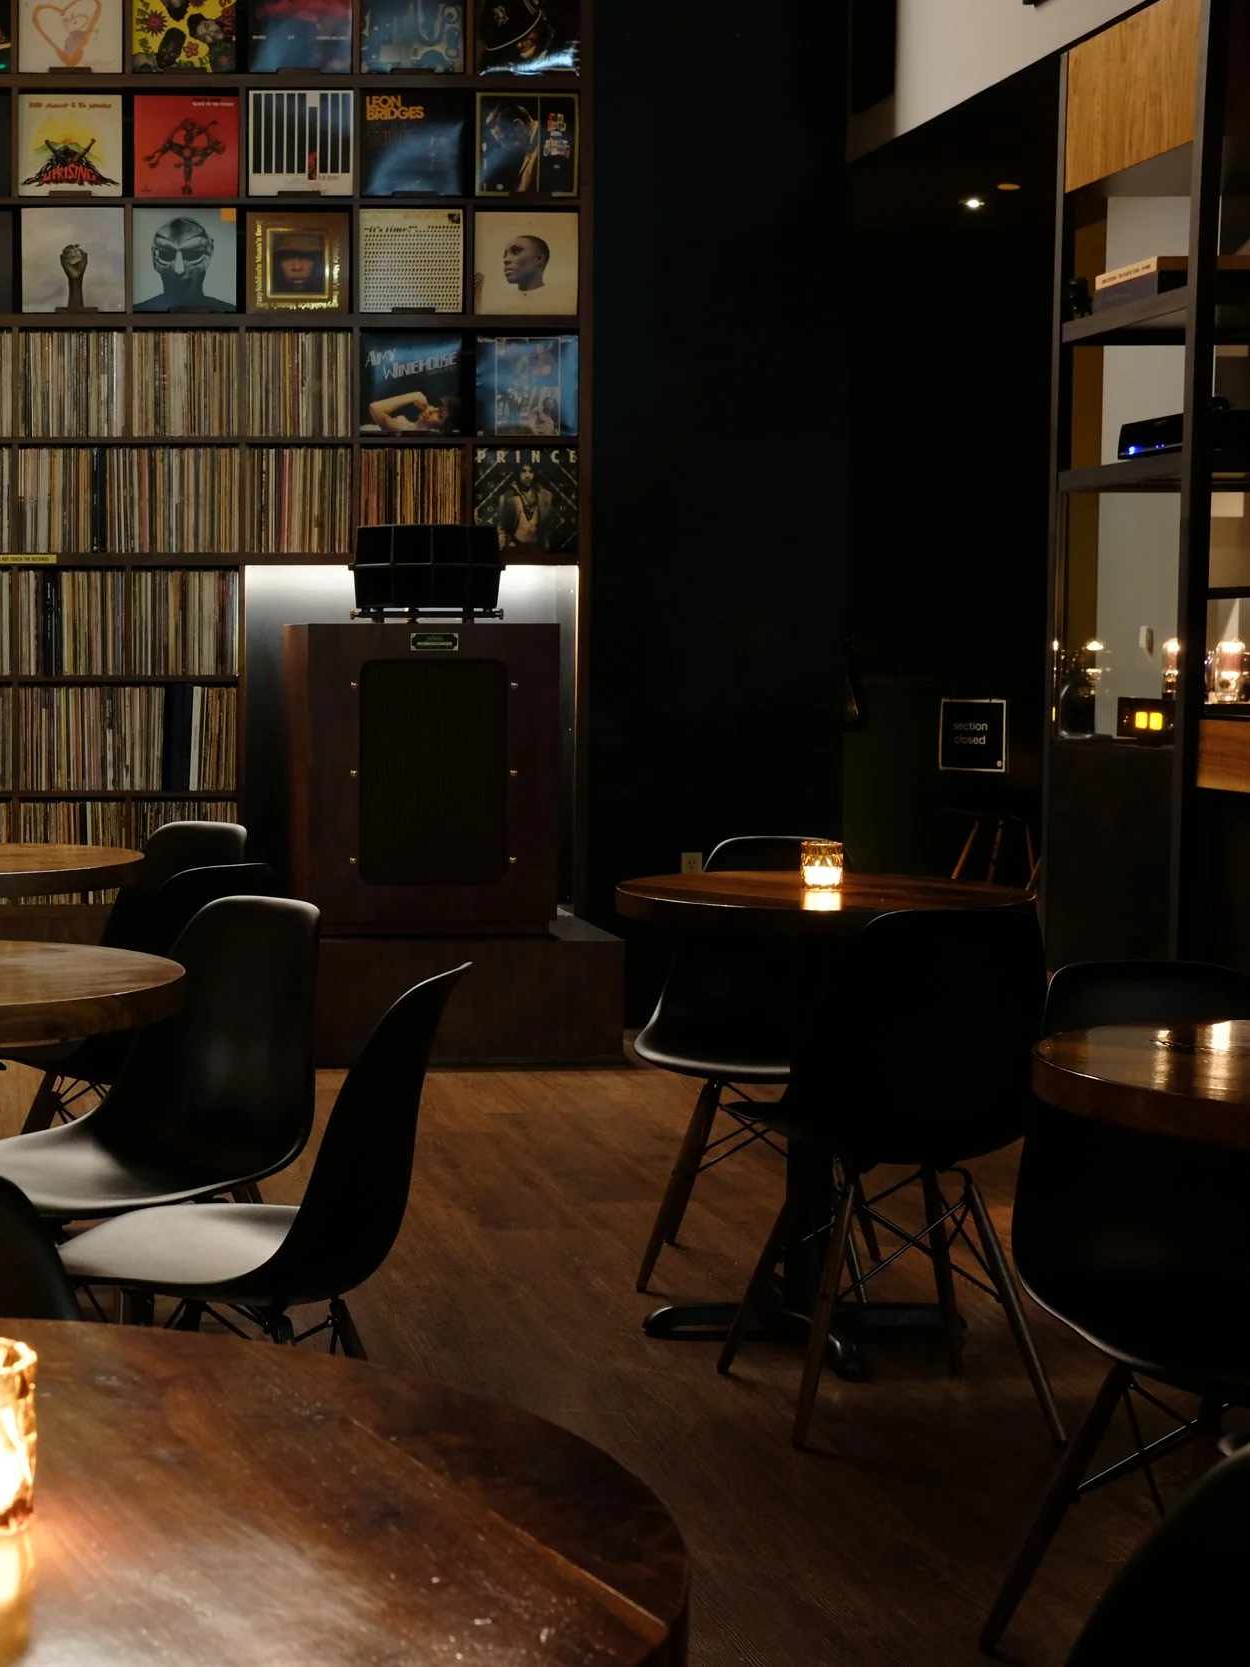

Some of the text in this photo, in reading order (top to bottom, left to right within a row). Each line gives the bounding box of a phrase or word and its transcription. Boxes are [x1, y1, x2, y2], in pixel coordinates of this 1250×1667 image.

[365, 95, 401, 107] LEON
[365, 106, 425, 121] BRIDGES
[42, 163, 97, 182] UPRISING
[364, 348, 397, 368] AMY
[382, 351, 458, 380] WINEHOUSE
[476, 450, 578, 464] PRINCE
[953, 722, 989, 732] section
[954, 735, 987, 745] closed
